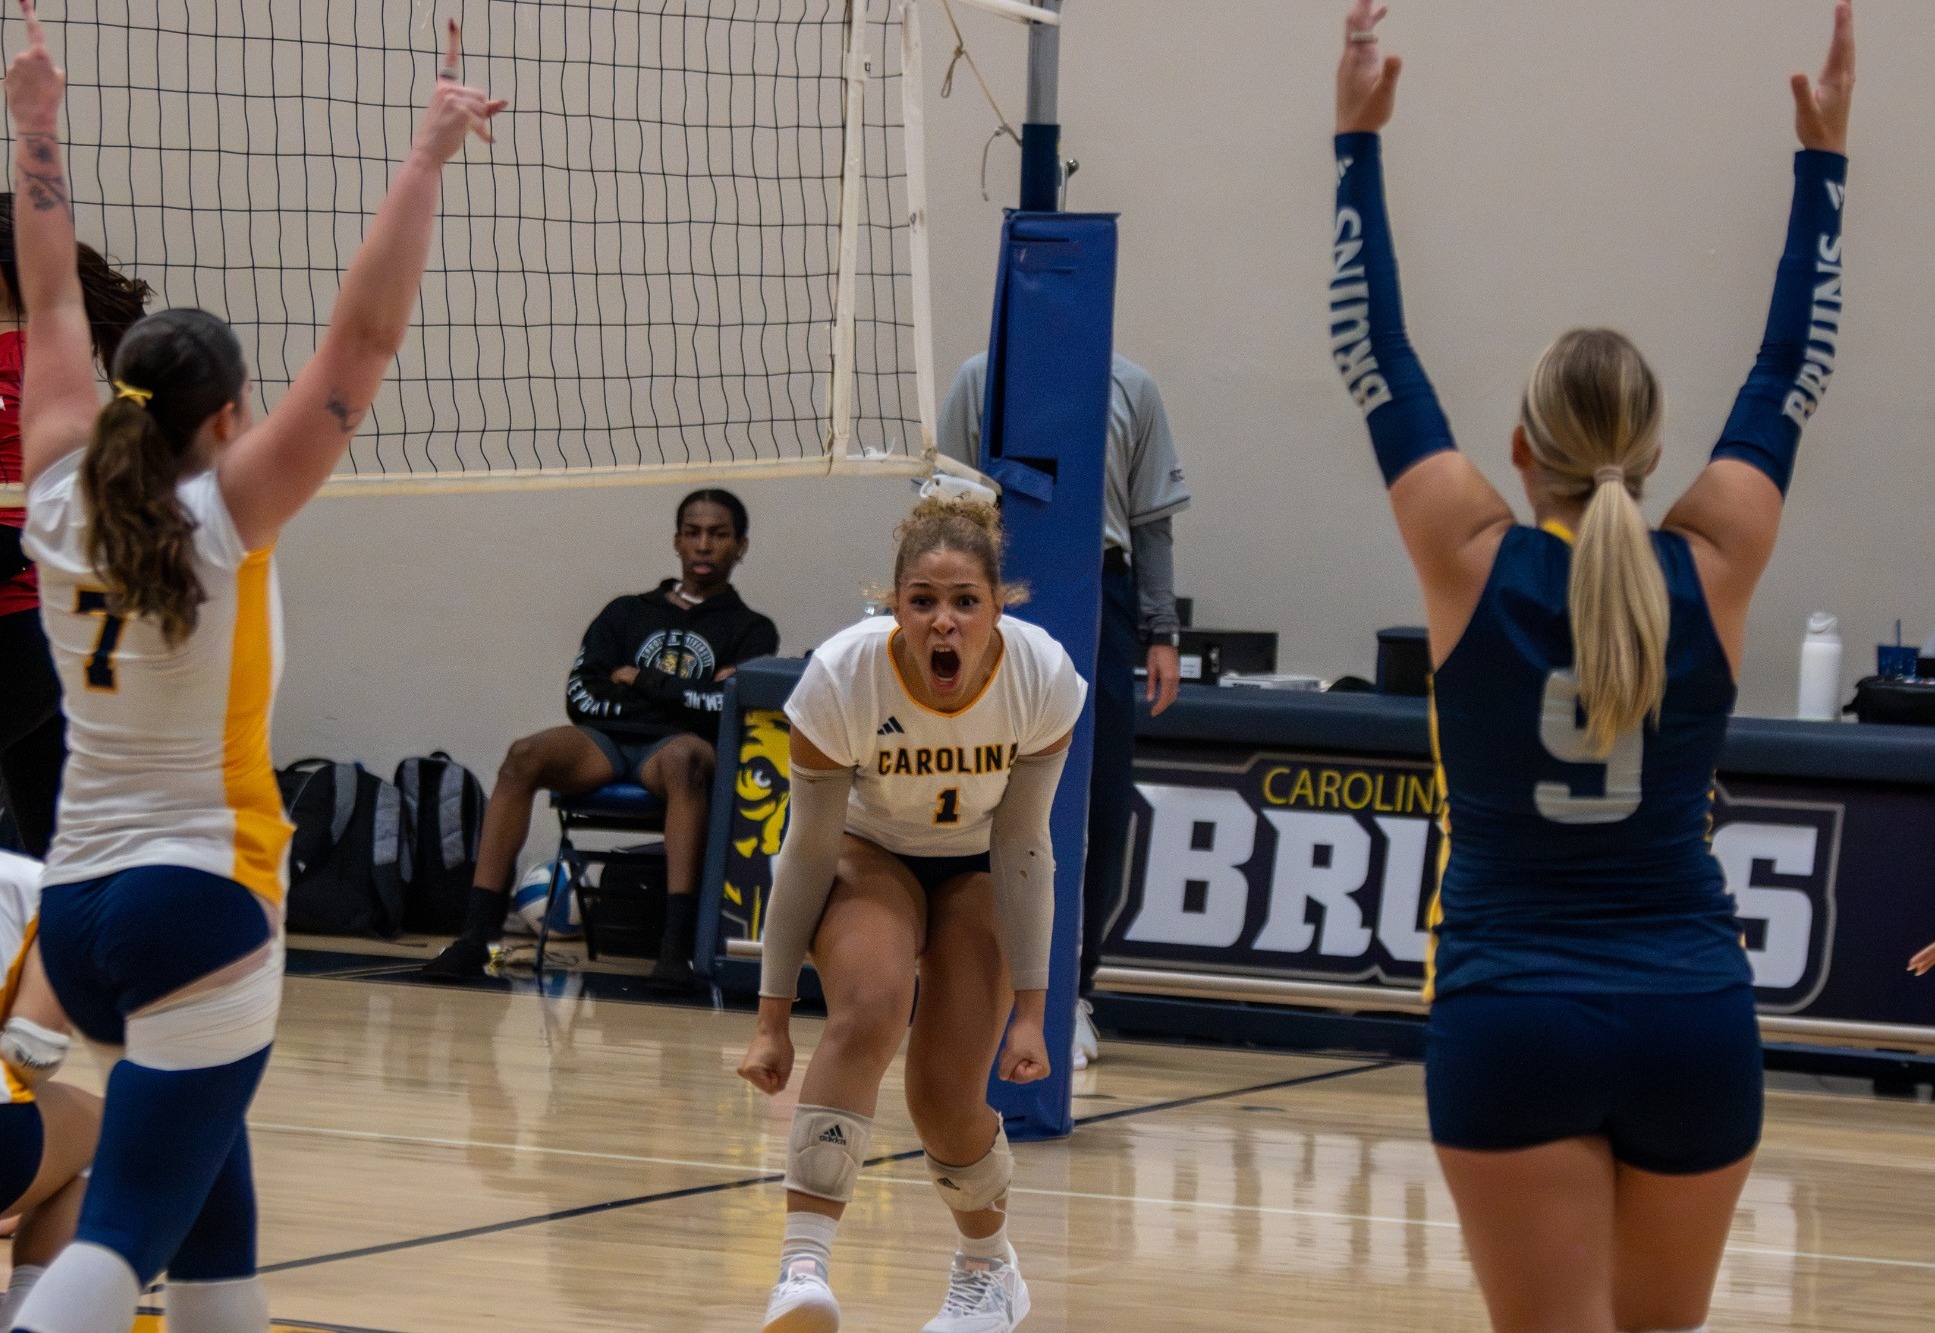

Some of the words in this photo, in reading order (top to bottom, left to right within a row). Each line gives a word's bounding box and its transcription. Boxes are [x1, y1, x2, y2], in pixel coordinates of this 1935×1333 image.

[1329, 206, 1393, 419] BRUINS
[1783, 234, 1842, 428] BRUINS
[74, 585, 137, 694] 7
[931, 787, 959, 825] 1
[1263, 767, 1442, 814] CAROLIN
[1534, 668, 1643, 824] 9
